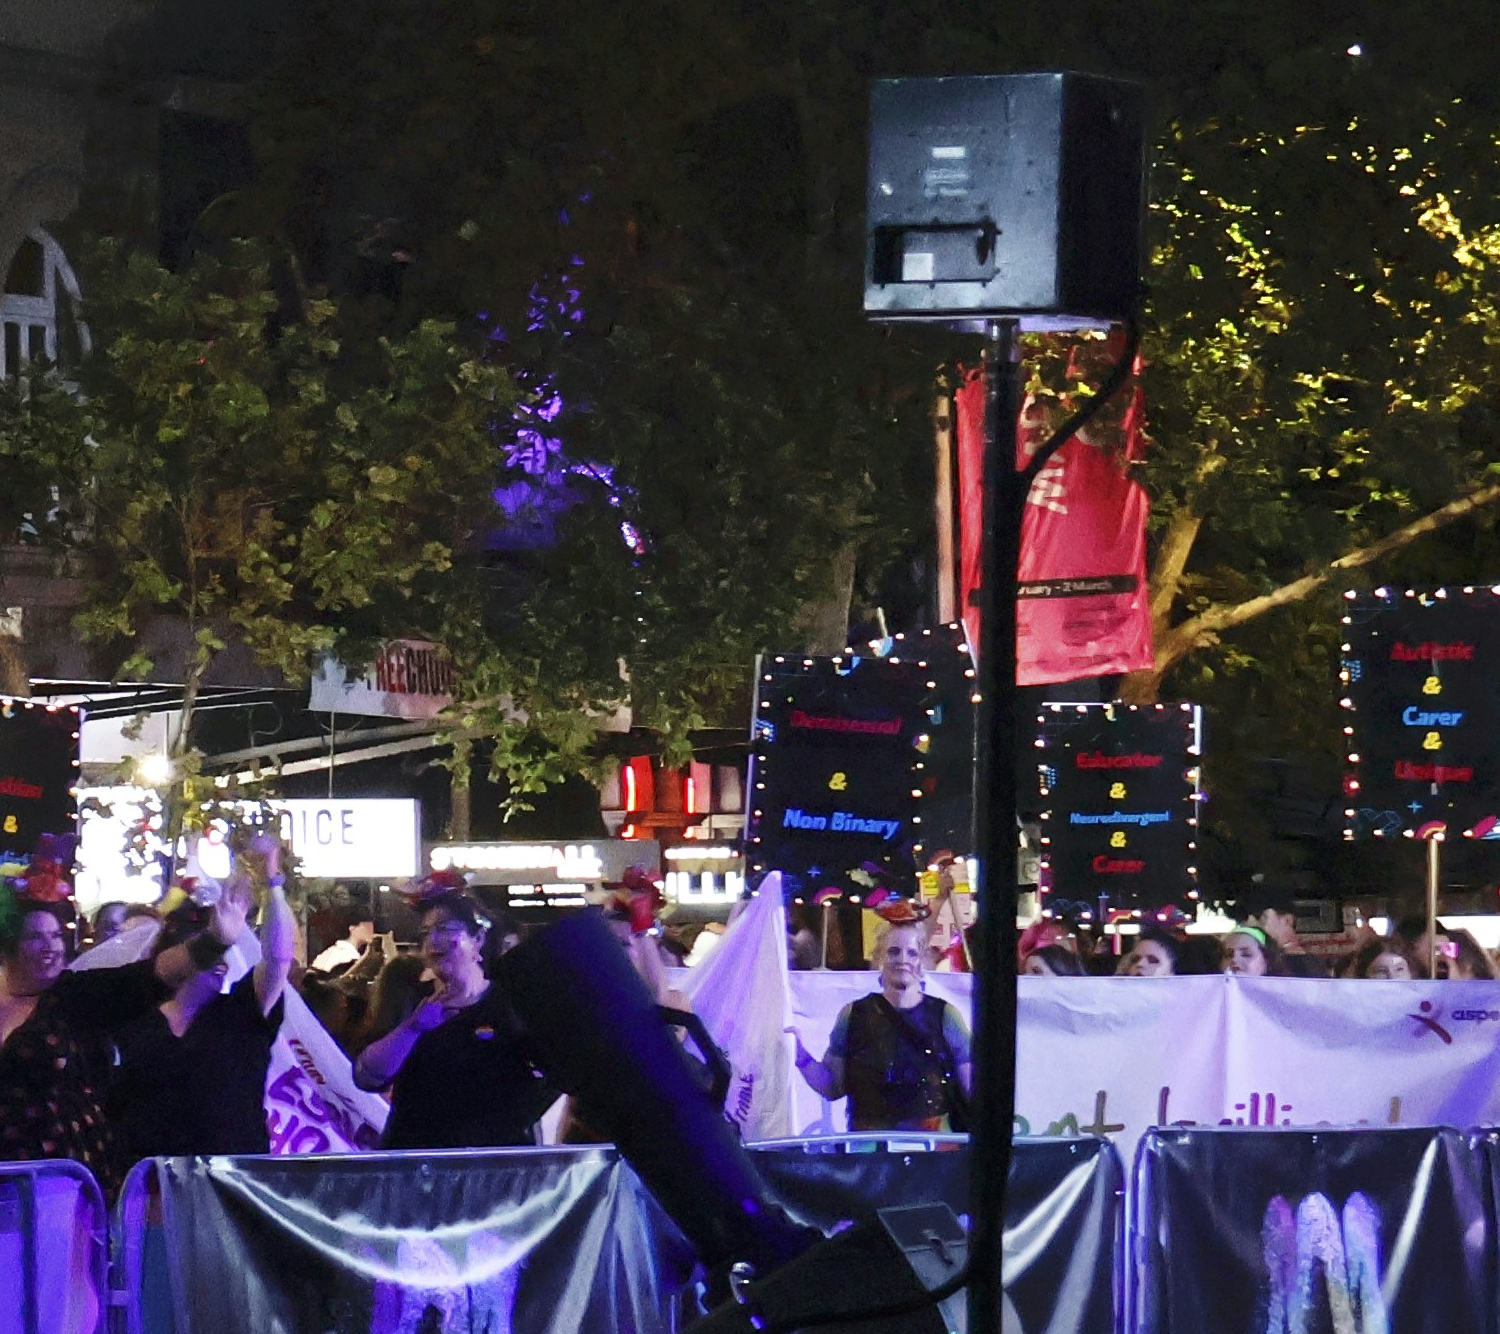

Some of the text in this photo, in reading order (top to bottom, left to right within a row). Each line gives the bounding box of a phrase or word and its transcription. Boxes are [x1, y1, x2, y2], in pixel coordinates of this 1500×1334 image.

[1402, 706, 1463, 727] Carer
[783, 808, 900, 840] Non Binary
